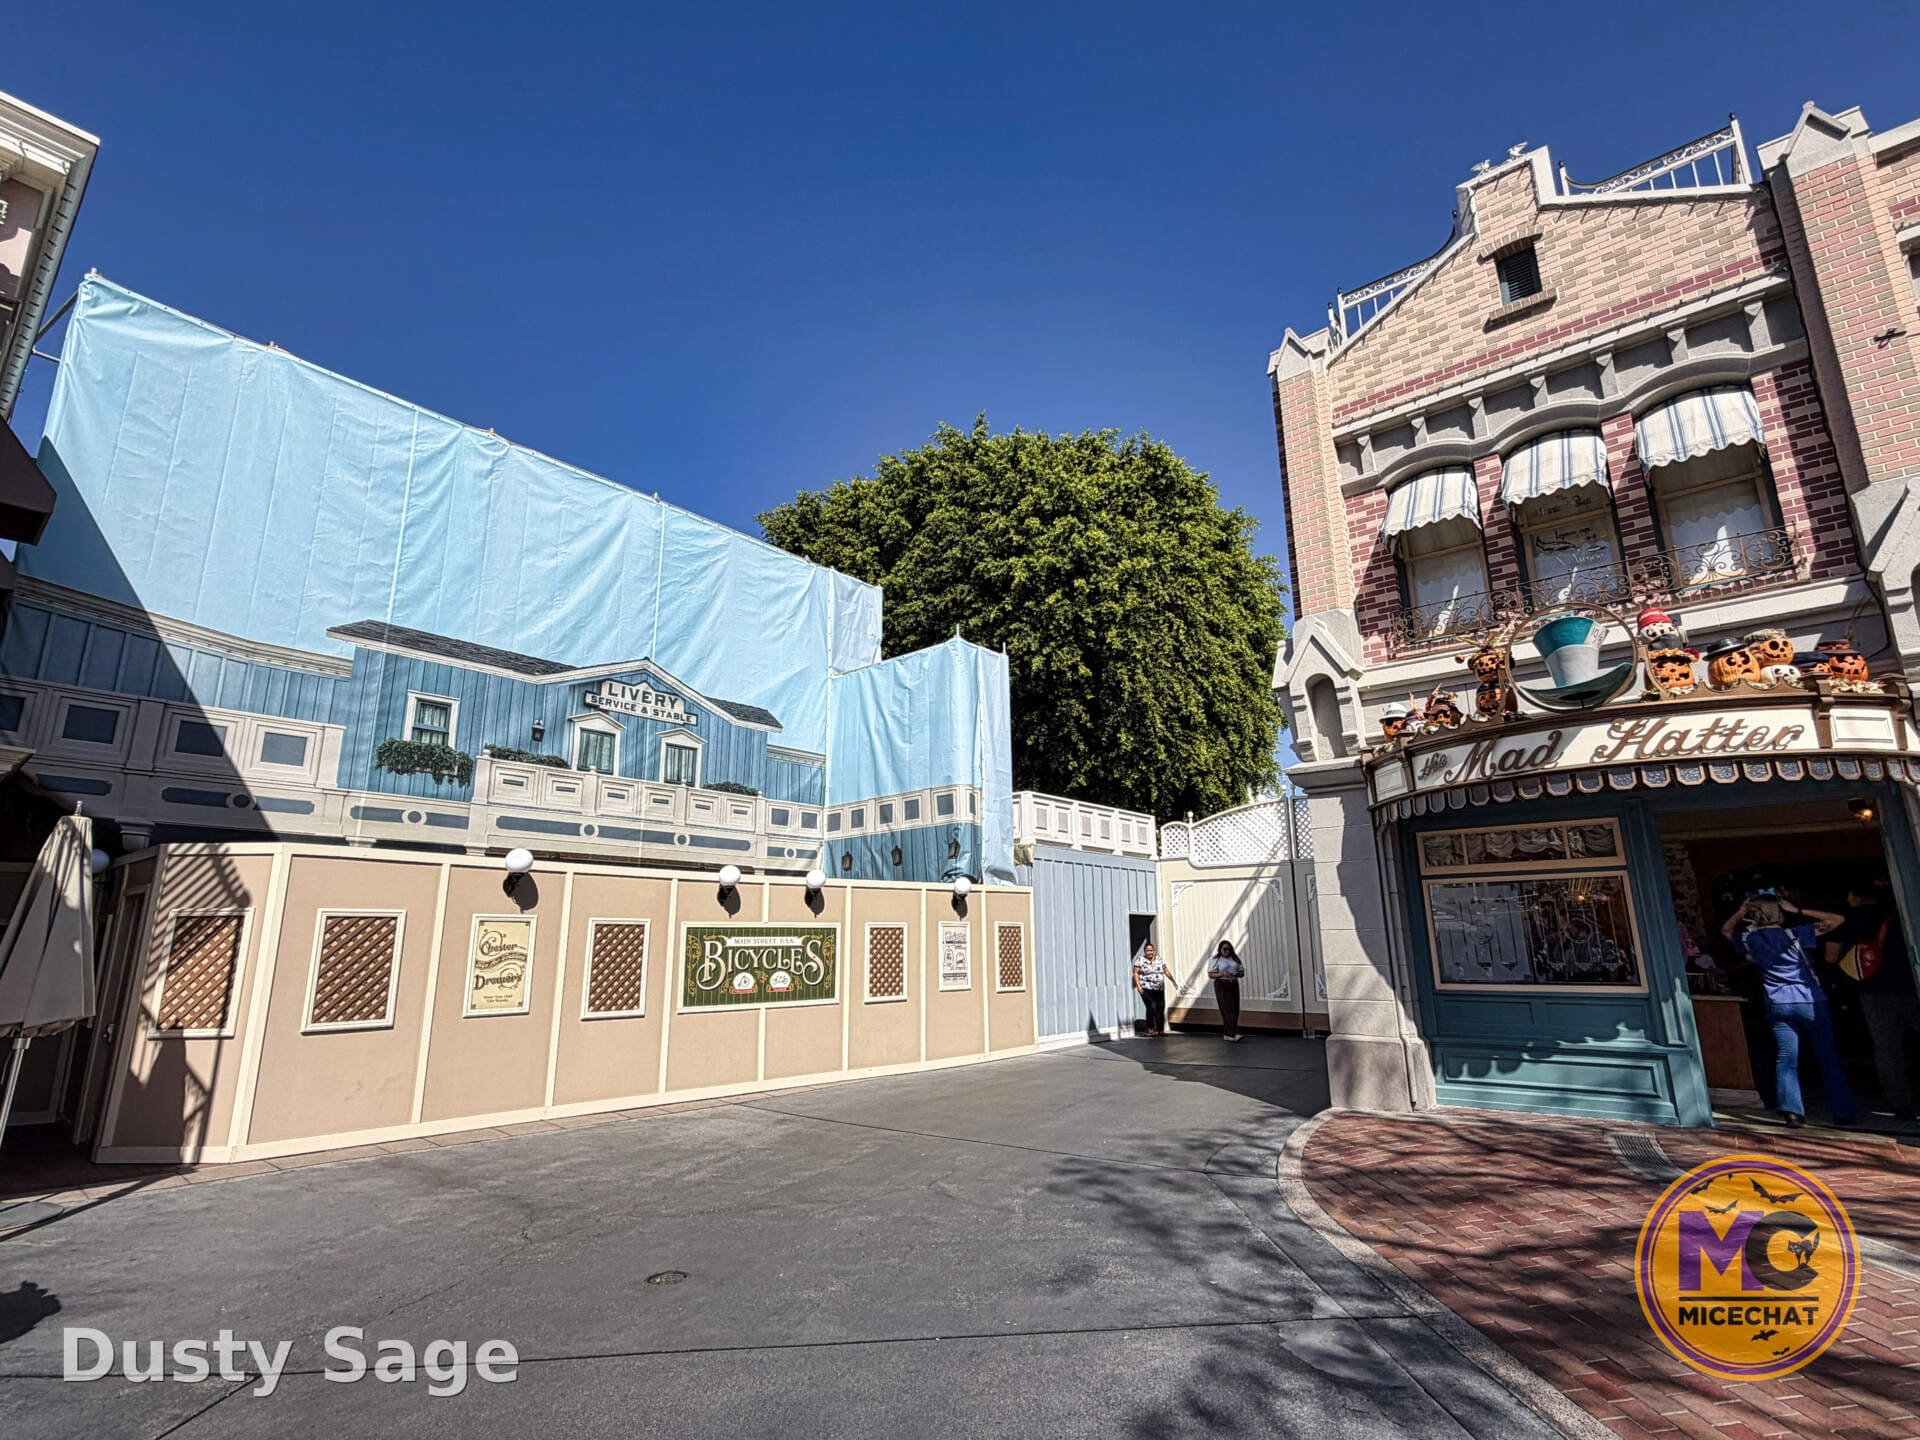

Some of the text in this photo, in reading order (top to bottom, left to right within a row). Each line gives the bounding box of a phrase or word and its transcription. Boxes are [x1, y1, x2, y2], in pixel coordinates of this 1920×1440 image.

[590, 695, 693, 723] SERVICE & STABLE
[607, 683, 679, 710] LIVERY
[1443, 730, 1565, 784] Mad
[1589, 716, 1805, 763] Hatter
